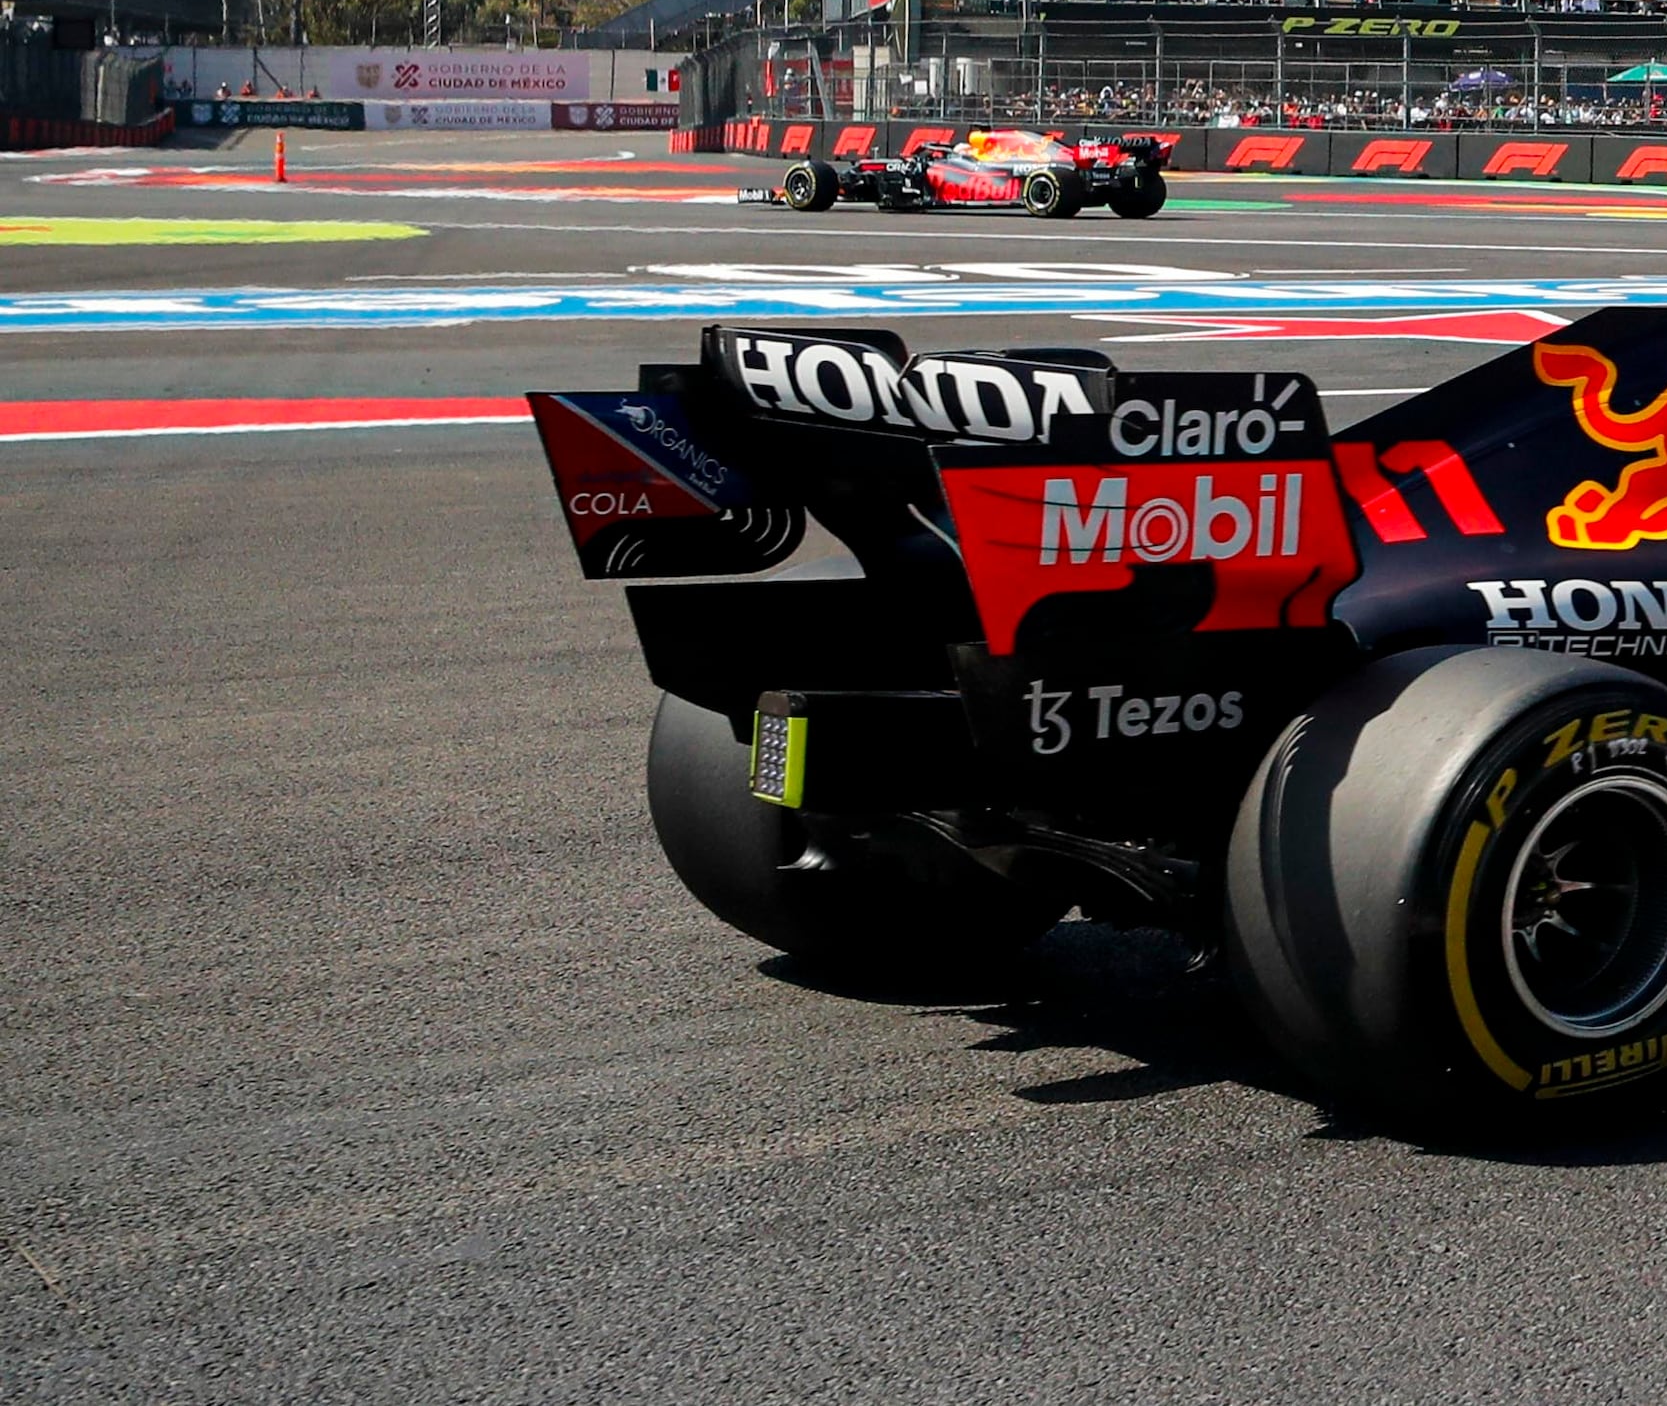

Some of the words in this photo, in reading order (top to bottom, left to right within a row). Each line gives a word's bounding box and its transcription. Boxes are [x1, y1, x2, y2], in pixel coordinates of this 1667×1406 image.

[1282, 16, 1316, 34] P
[1322, 17, 1461, 38] ZERO
[428, 64, 514, 75] GOBIERNO
[520, 64, 544, 75] DE
[547, 64, 567, 75] LA
[428, 77, 484, 89] CIUDAD
[489, 78, 506, 89] DE
[735, 336, 1096, 444] HONDA
[1109, 398, 1277, 457] Claro
[569, 492, 653, 515] COLA
[1039, 473, 1303, 566] Mobil
[1087, 684, 1244, 739] Tezos
[1485, 767, 1518, 829] P
